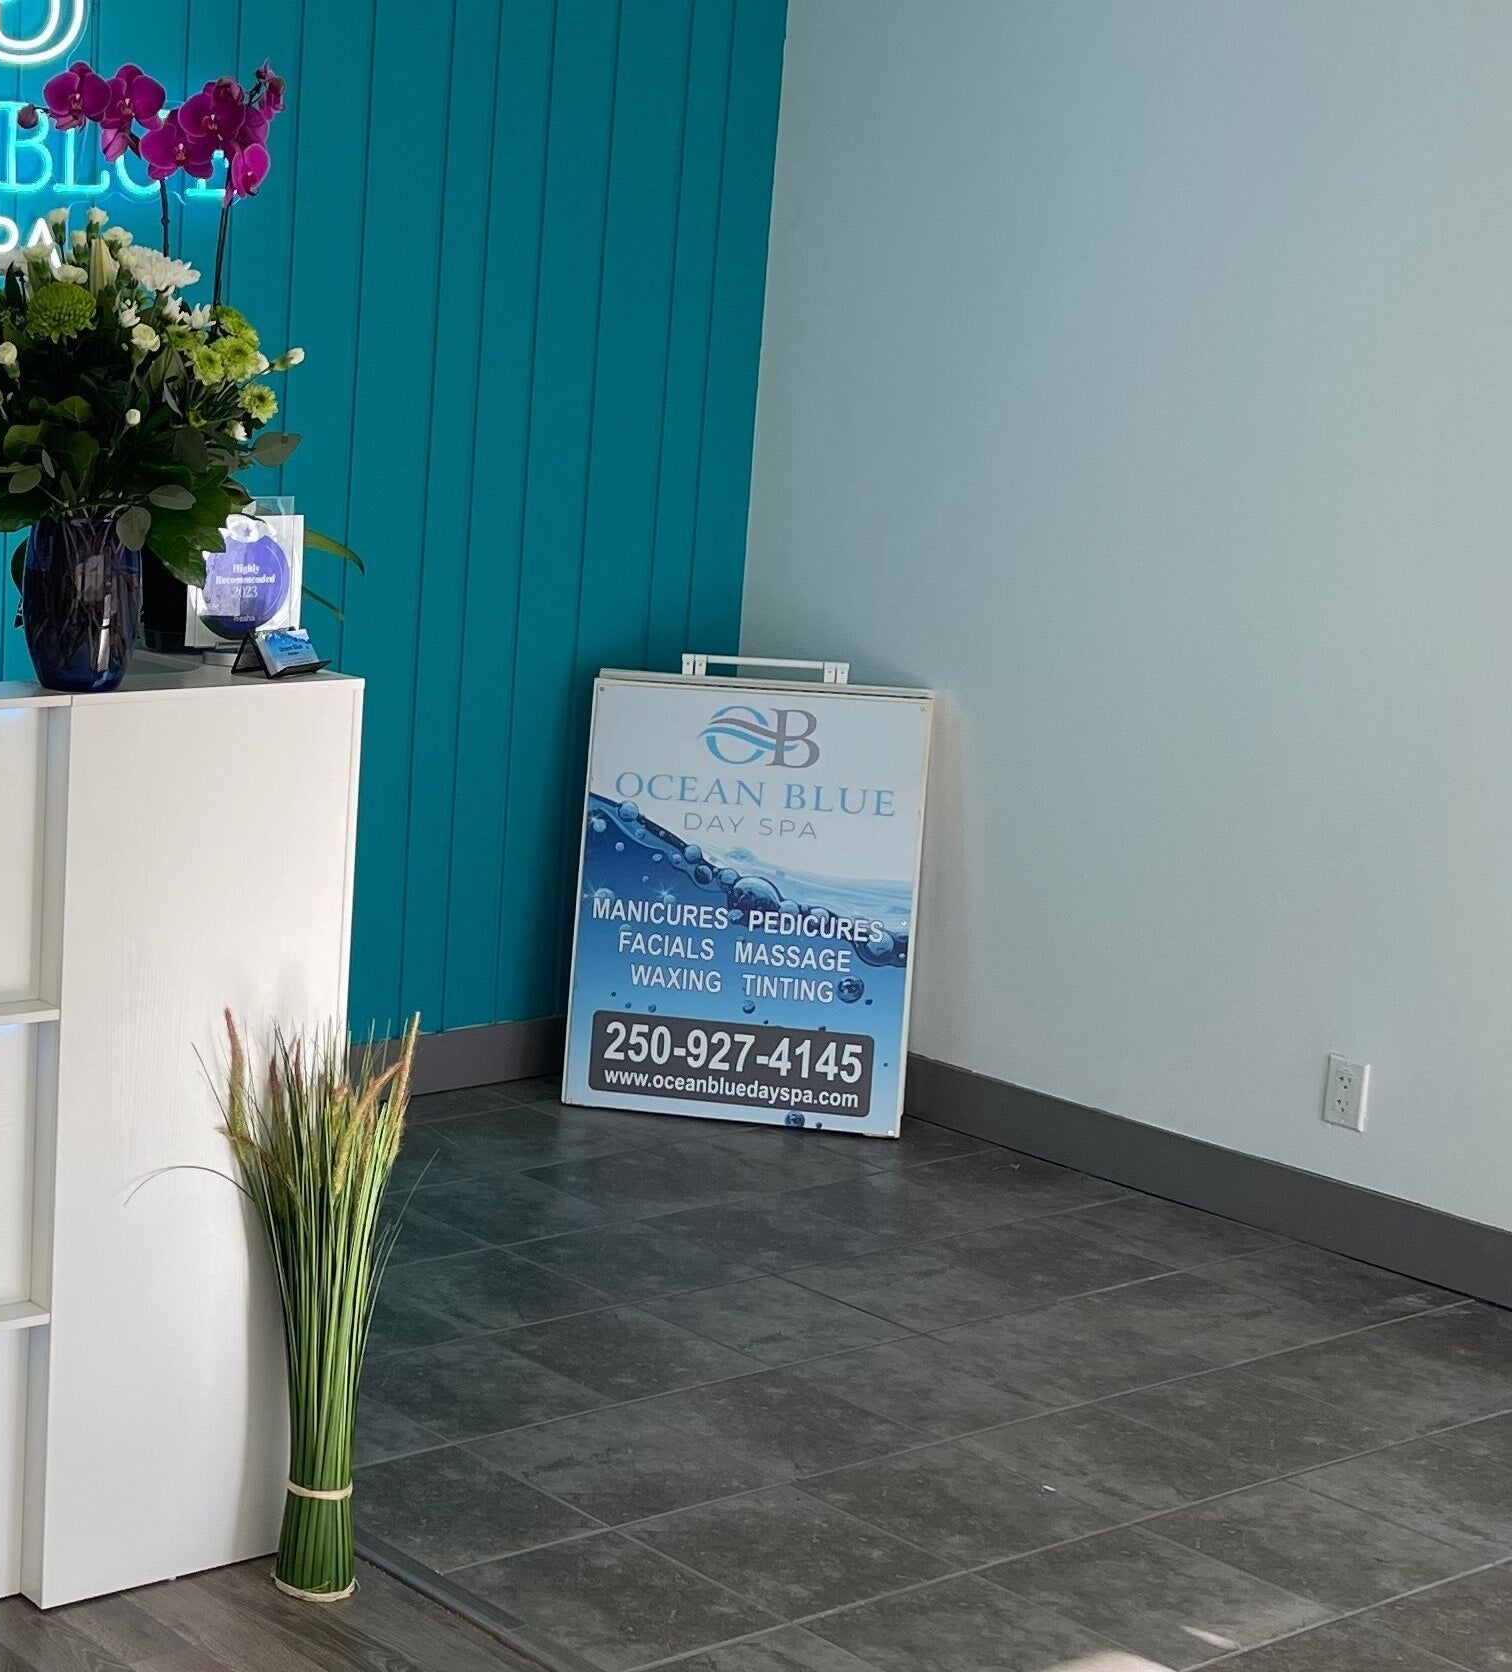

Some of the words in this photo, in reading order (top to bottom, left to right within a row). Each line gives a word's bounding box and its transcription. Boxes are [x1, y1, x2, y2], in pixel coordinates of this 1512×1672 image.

[215, 574, 276, 585] Recommended
[232, 563, 261, 575] Highly
[615, 771, 767, 808] OCEAN
[784, 783, 896, 817] BLUE
[683, 812, 745, 833] DAY
[759, 818, 818, 840] SPA
[592, 897, 729, 930] MANICURES
[748, 909, 885, 943] PEDICURES
[618, 930, 715, 961] FACIALS
[734, 941, 852, 973] MASSAGE
[630, 964, 722, 993] WAXING
[742, 974, 834, 1003] TINTING
[603, 1021, 863, 1084] 250-927-4145
[604, 1069, 859, 1108] www.oceanbluedayspa.com
